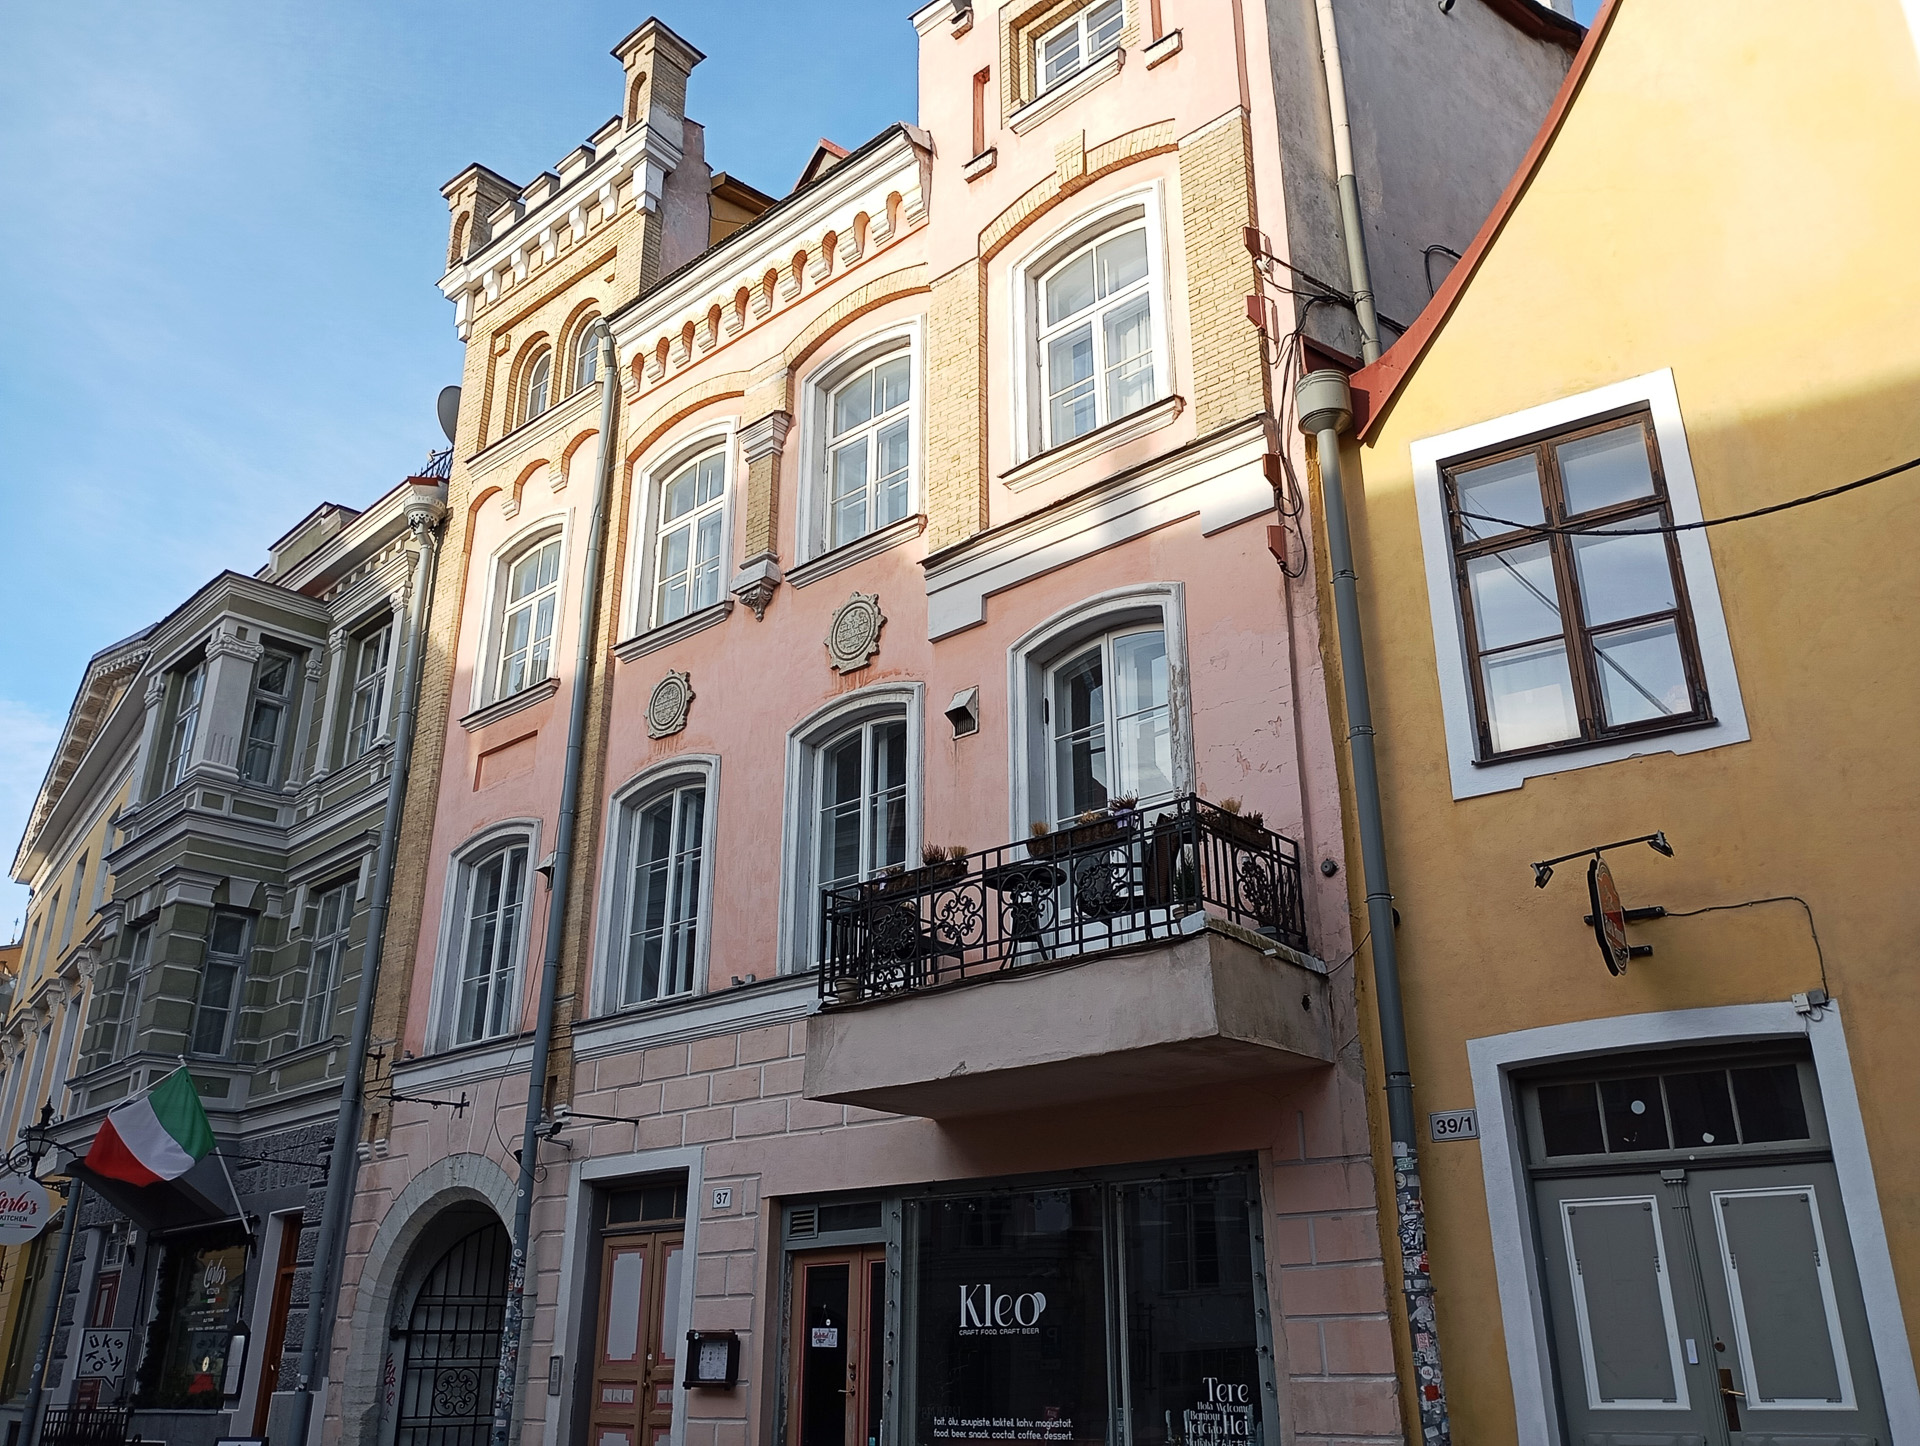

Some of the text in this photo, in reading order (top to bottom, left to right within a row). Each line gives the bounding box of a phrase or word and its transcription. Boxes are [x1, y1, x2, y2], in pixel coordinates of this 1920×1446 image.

[1436, 1116, 1473, 1134] 39/1
[715, 1192, 728, 1205] 37
[959, 1283, 1046, 1328] Kleo
[1021, 1327, 1040, 1335] BEER
[1202, 1377, 1249, 1403] Tere
[1196, 1401, 1214, 1411] Hola
[1190, 1410, 1221, 1421] Bonjour
[1223, 1415, 1250, 1436] Hei
[1043, 1430, 1074, 1441] dessert.
